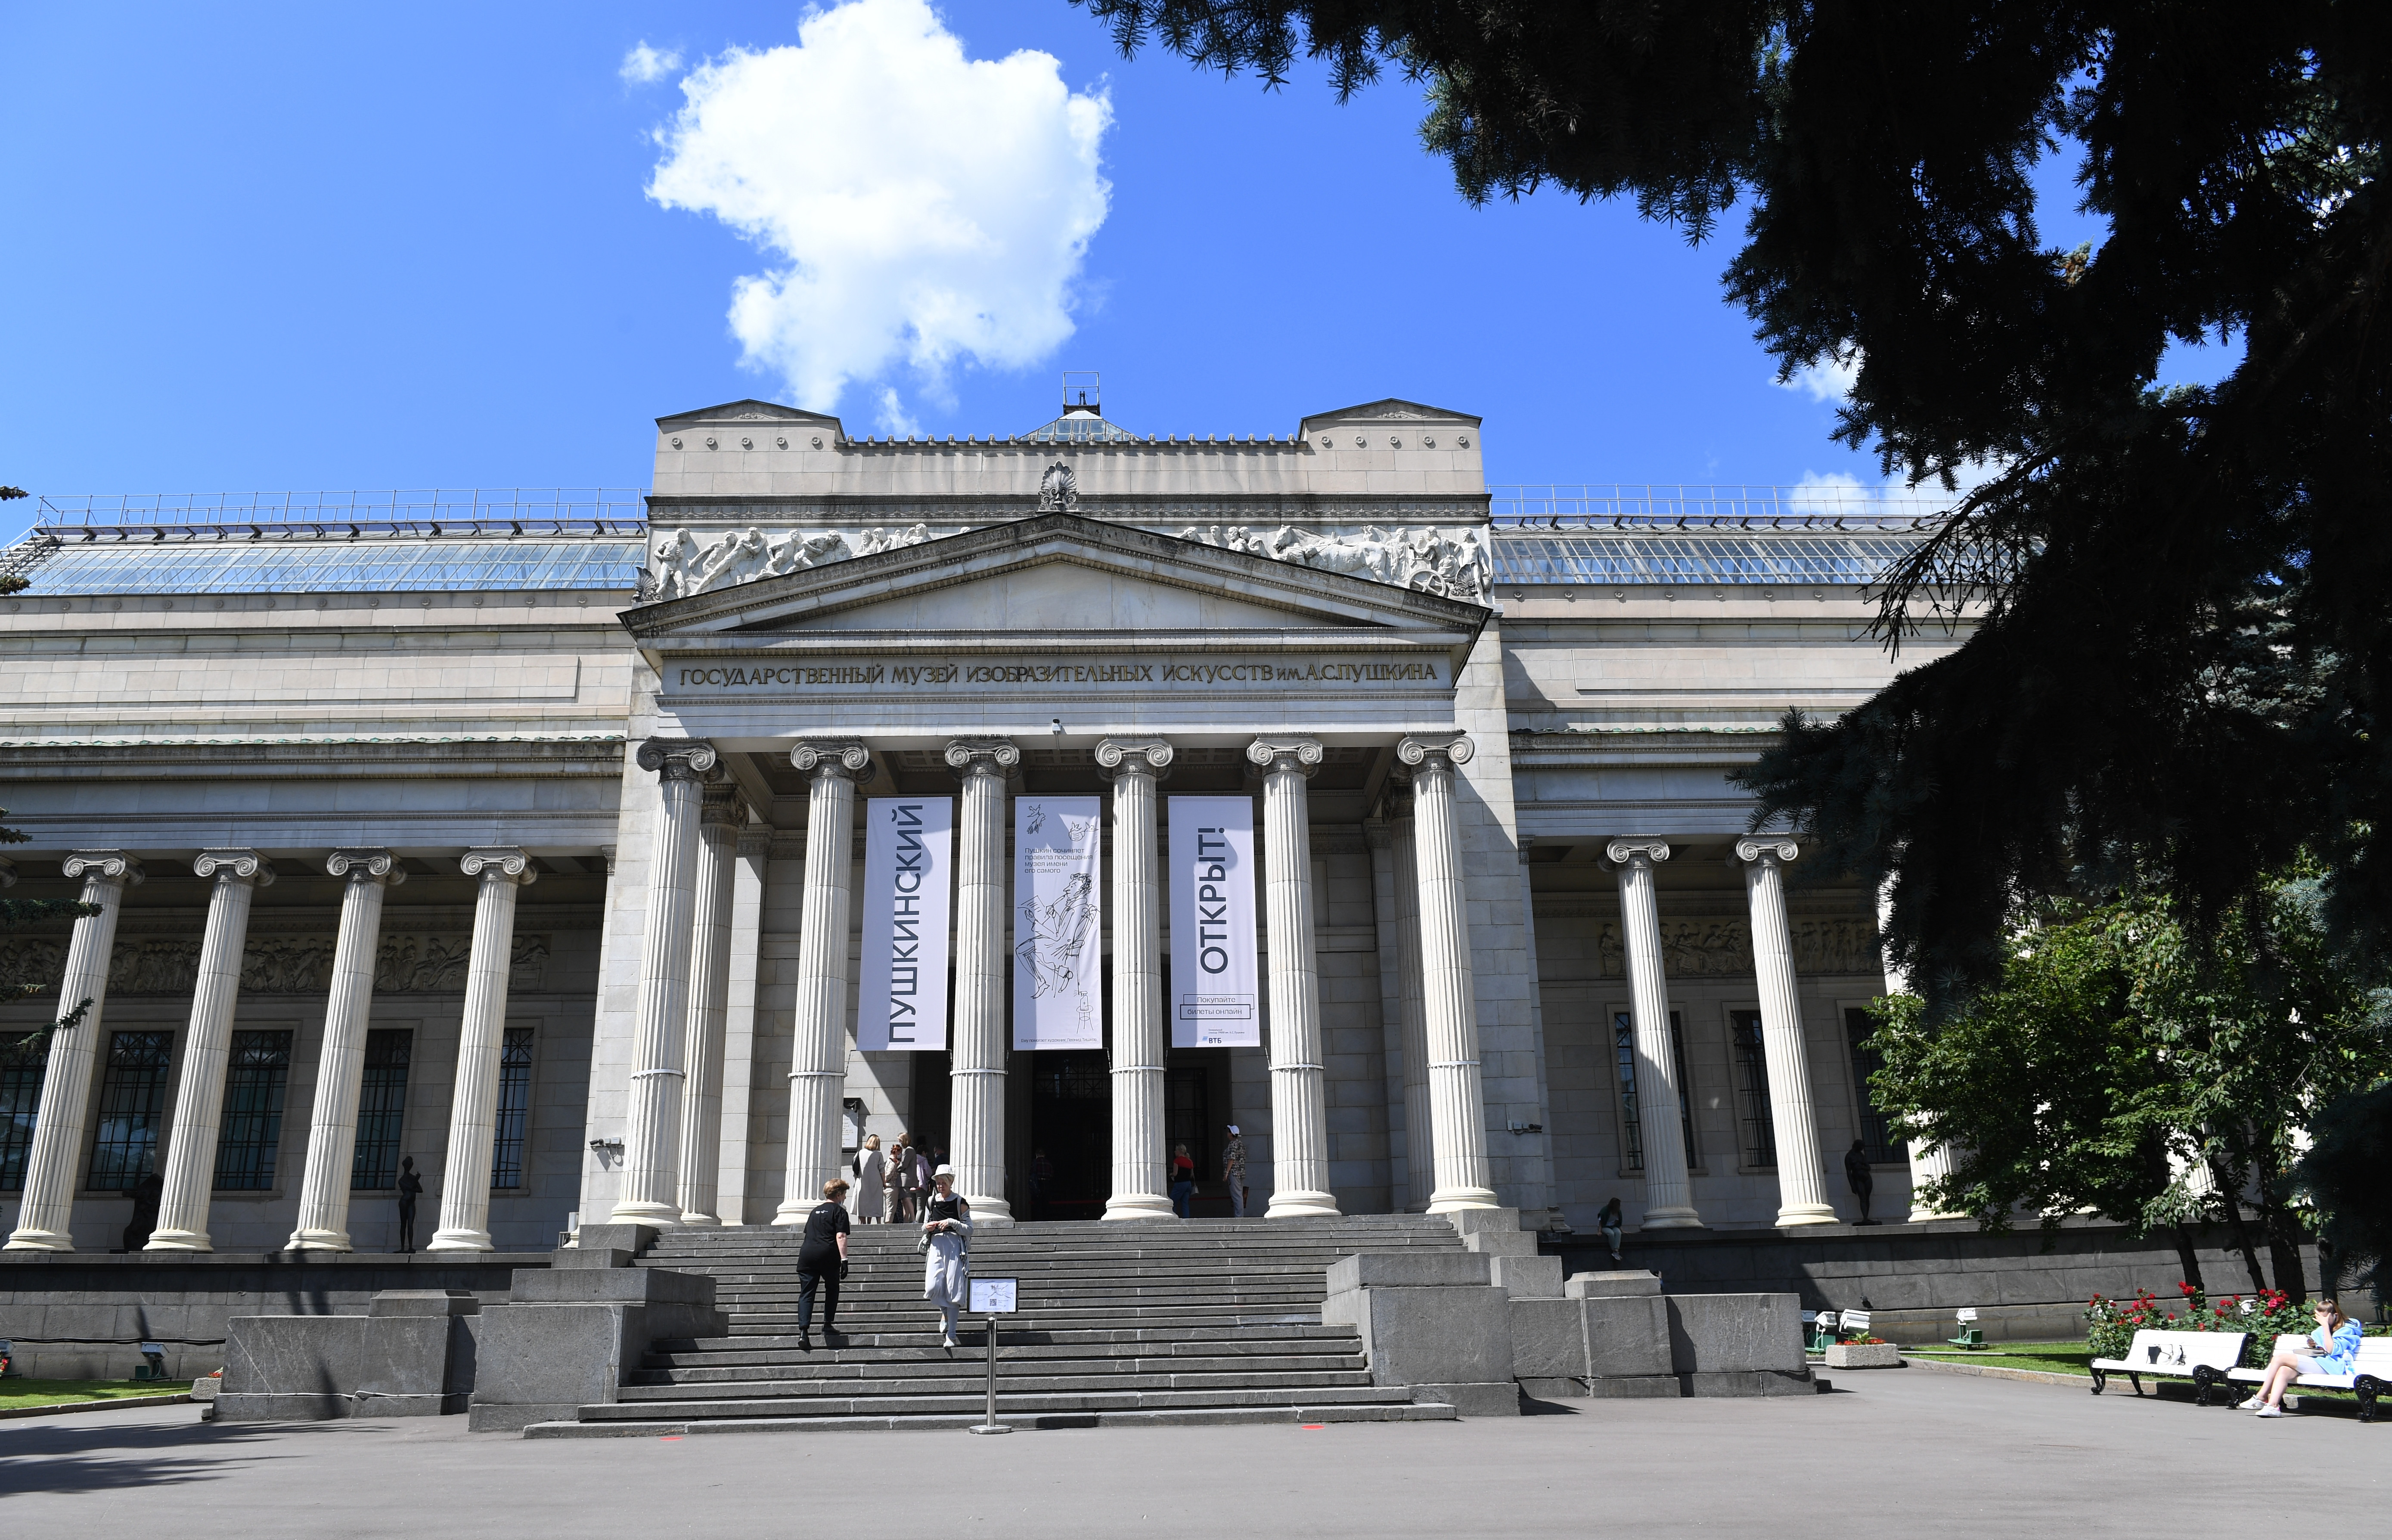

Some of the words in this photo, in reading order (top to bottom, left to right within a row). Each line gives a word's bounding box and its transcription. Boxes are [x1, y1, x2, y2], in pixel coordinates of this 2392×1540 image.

[679, 663, 884, 686] ГОСУДАРСТВЕННЫЙ
[891, 663, 959, 685] МУЗЕЙ
[966, 665, 1154, 682] ИЗОБРАЗИТЕЛЬНЫХ
[1162, 665, 1273, 683] ИСКУССТВ
[889, 805, 923, 1043] ПУШКИНСКИЙ
[1198, 827, 1229, 974] ОТКРЫТ!
